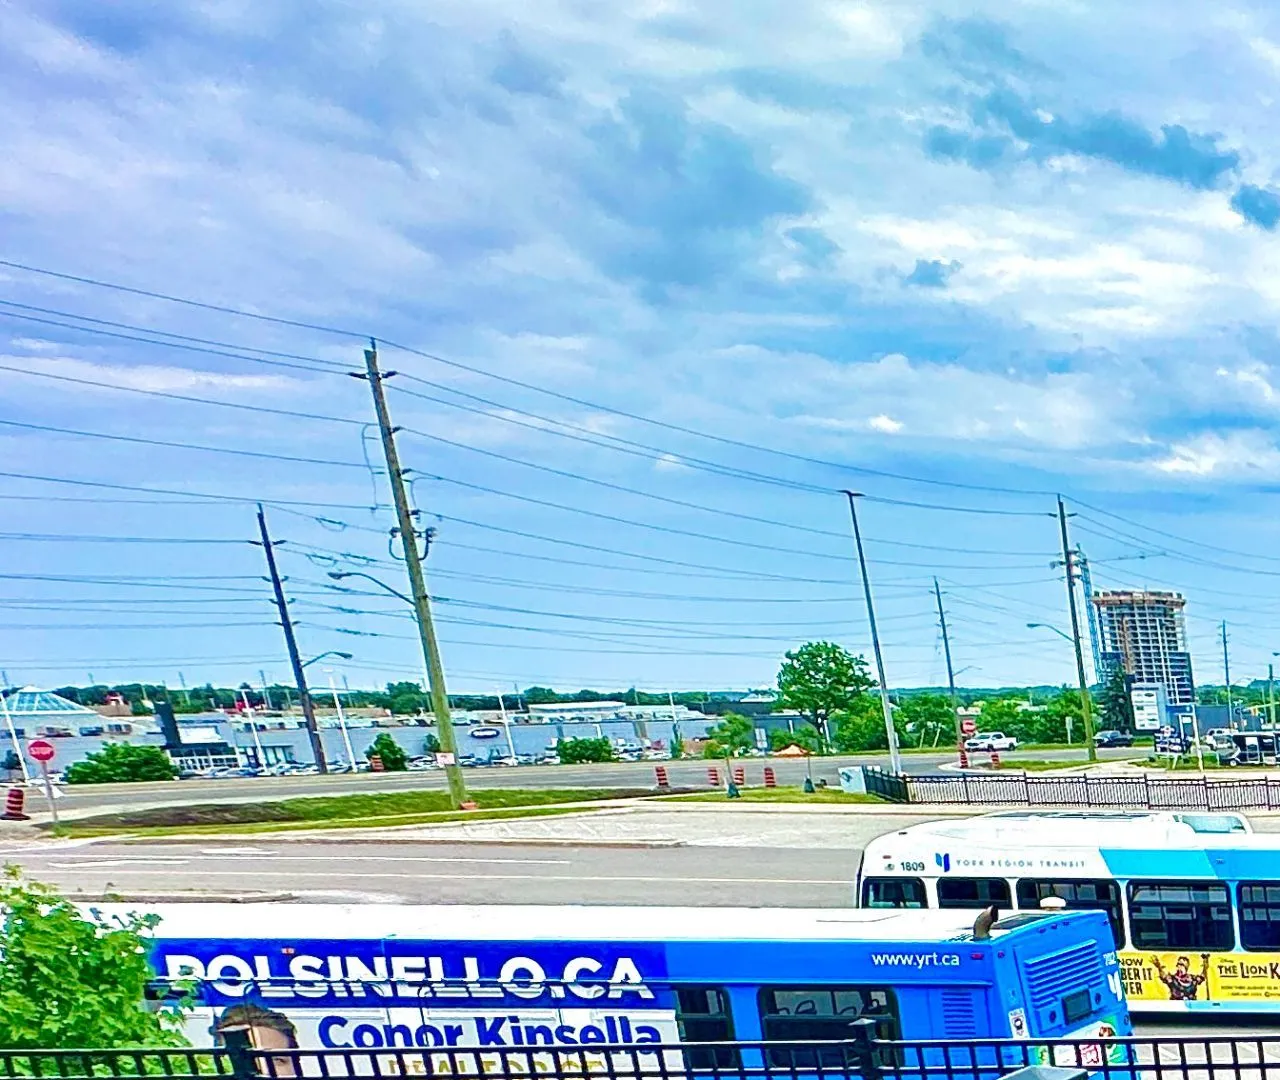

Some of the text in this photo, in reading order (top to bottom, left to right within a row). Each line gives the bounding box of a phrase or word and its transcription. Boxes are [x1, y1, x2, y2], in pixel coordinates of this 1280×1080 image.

[900, 862, 925, 871] 1809
[991, 860, 1032, 868] REGION
[1040, 860, 1086, 868] TRANSIT
[872, 952, 960, 969] www.yrt.ca
[1142, 968, 1152, 980] IT
[1217, 965, 1237, 975] THE
[165, 954, 655, 999] POLSINELLO.CA
[319, 1015, 661, 1053] Conor Kinsella
